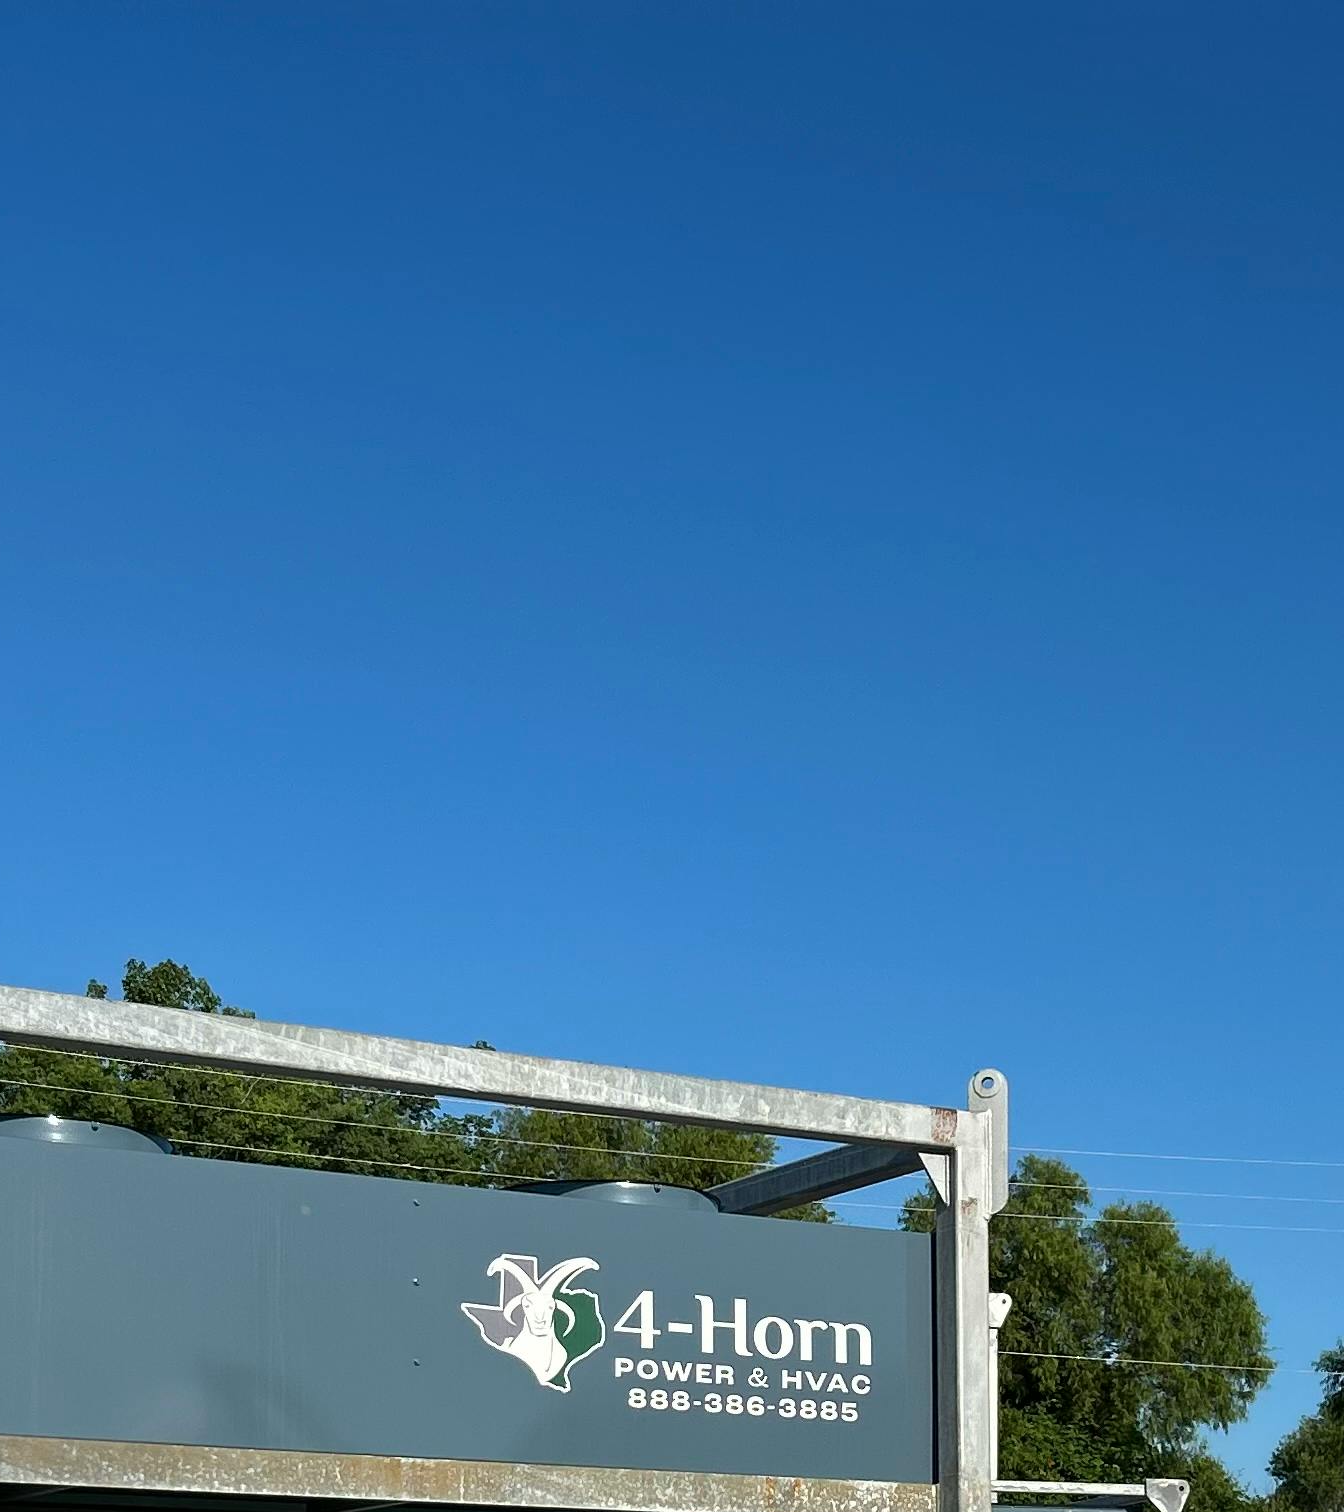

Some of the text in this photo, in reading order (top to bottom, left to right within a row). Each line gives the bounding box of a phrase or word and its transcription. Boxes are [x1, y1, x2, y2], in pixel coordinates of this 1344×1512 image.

[613, 1290, 872, 1366] 4-Horn
[614, 1357, 871, 1396] POWER & HVAC
[627, 1387, 858, 1422] 888-386-3885
